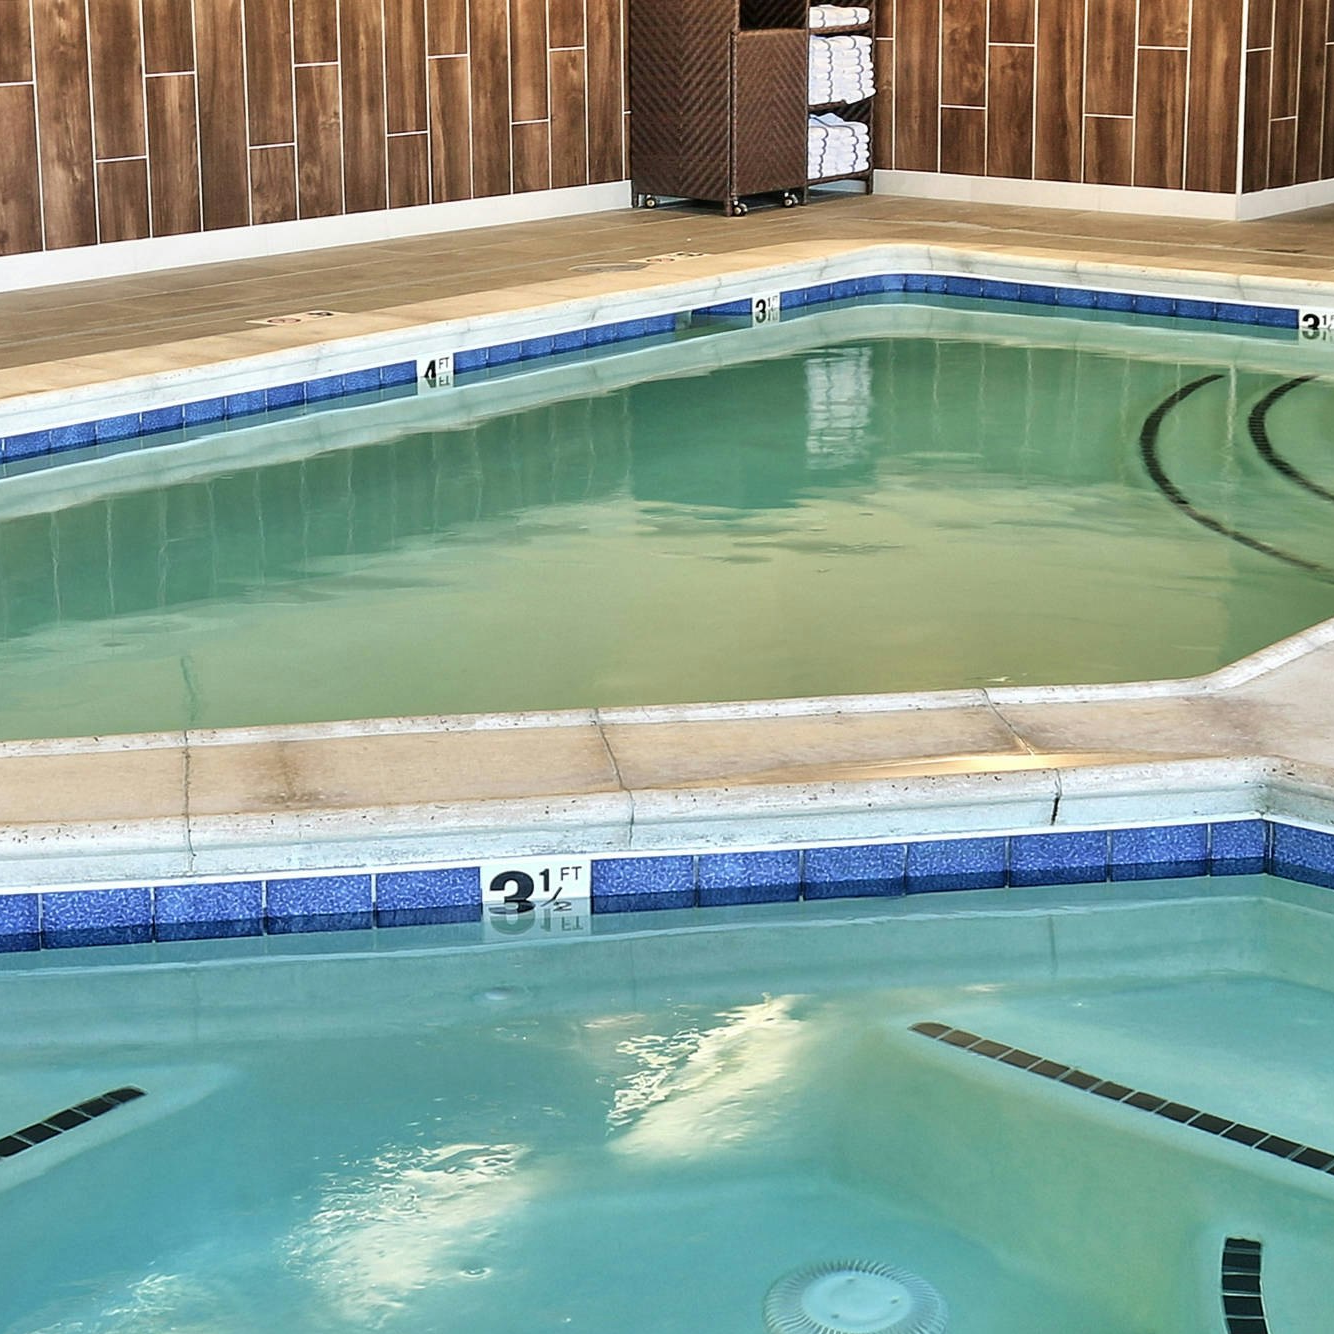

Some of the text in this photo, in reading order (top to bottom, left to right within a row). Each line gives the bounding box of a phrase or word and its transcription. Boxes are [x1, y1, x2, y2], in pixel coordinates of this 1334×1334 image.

[424, 357, 450, 379] 4 FT
[488, 870, 536, 915] 3
[560, 866, 582, 881] FT
